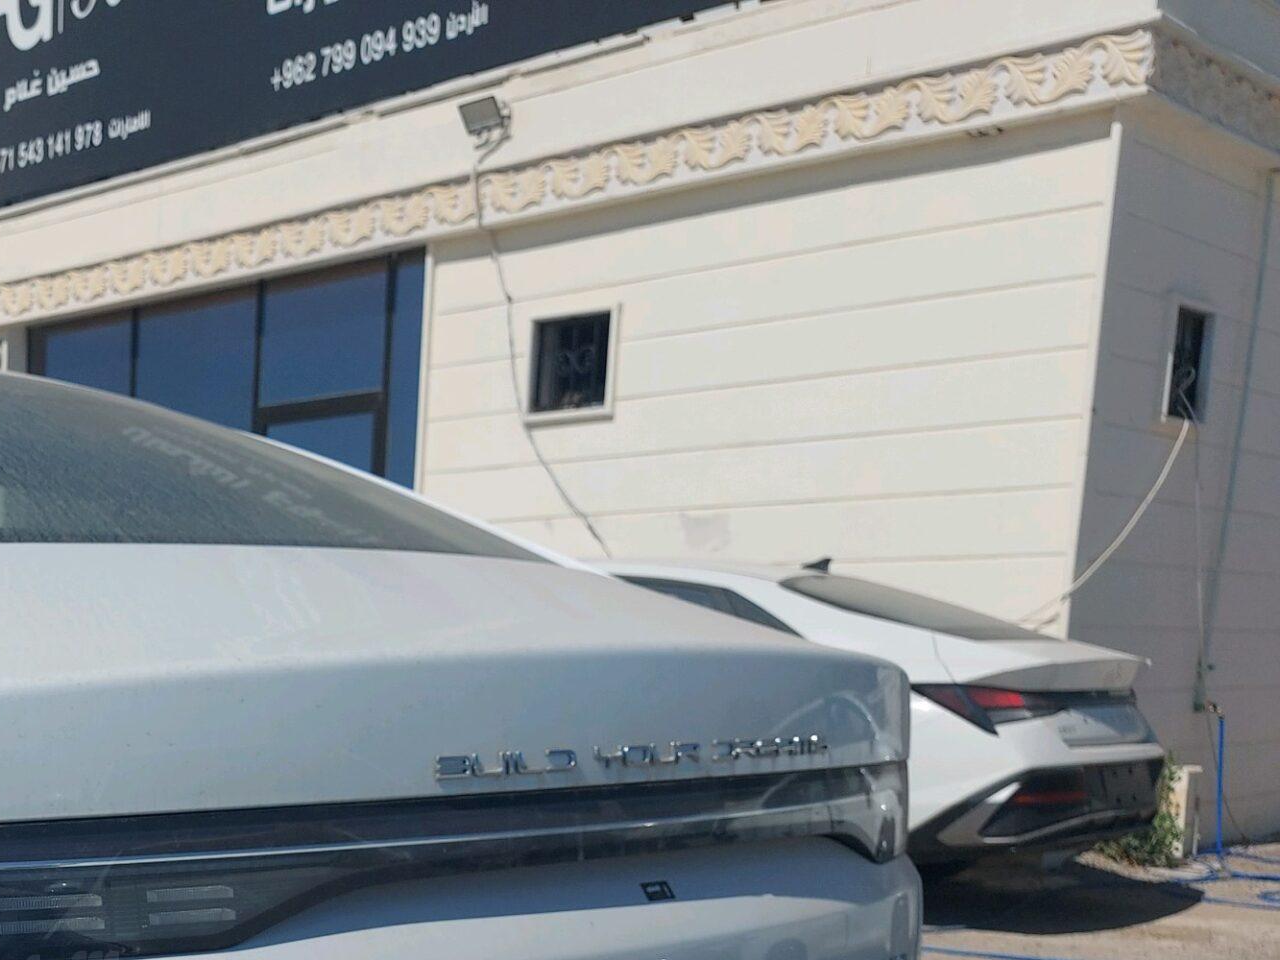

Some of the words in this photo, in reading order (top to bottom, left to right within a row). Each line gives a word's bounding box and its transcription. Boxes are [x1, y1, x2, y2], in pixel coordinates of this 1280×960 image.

[271, 51, 316, 91] +962
[321, 39, 356, 76] 799
[360, 26, 397, 64] 094
[402, 13, 440, 52] 939
[46, 59, 100, 96] حسين
[18, 137, 44, 168] 543
[47, 129, 71, 159] 141
